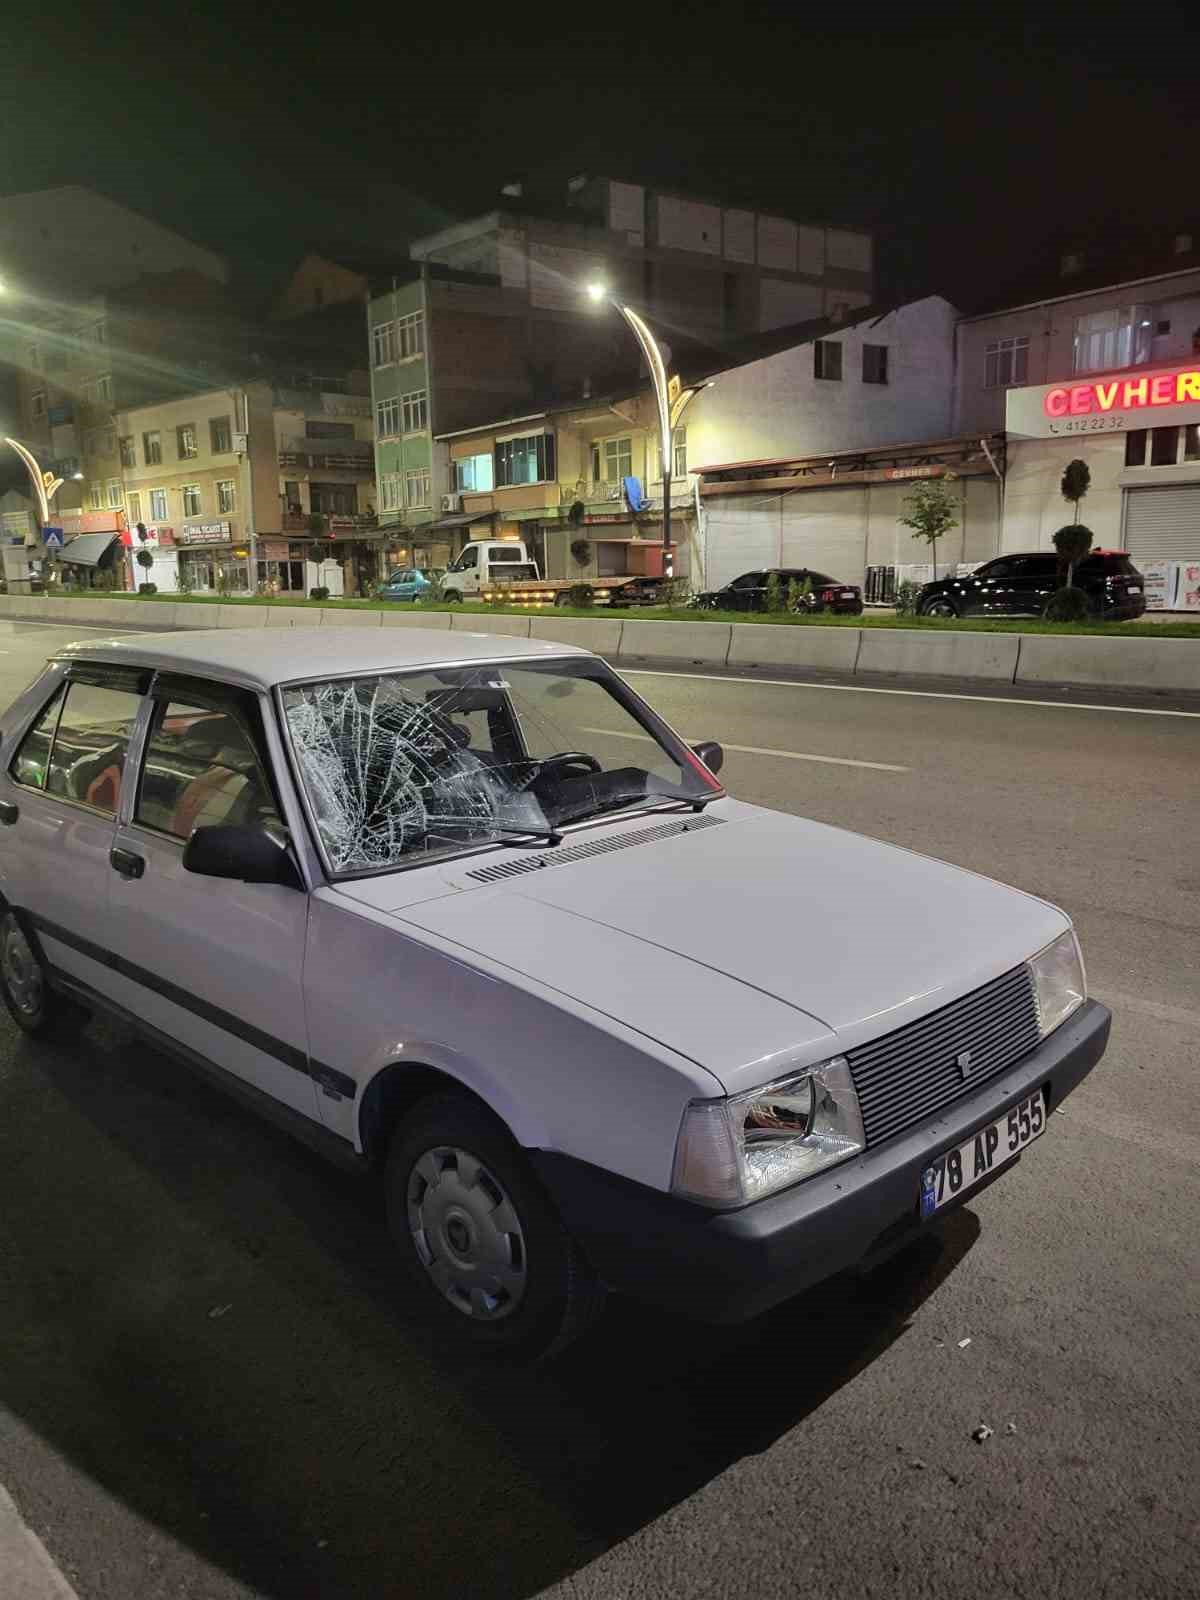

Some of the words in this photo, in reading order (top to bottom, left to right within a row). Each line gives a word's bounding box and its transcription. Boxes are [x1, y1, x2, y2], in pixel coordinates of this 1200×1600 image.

[1045, 372, 1200, 416] CEVHER
[1091, 417, 1105, 429] 22
[932, 1149, 962, 1201] 78
[975, 1125, 998, 1177] AP
[1007, 1094, 1042, 1151] 555
